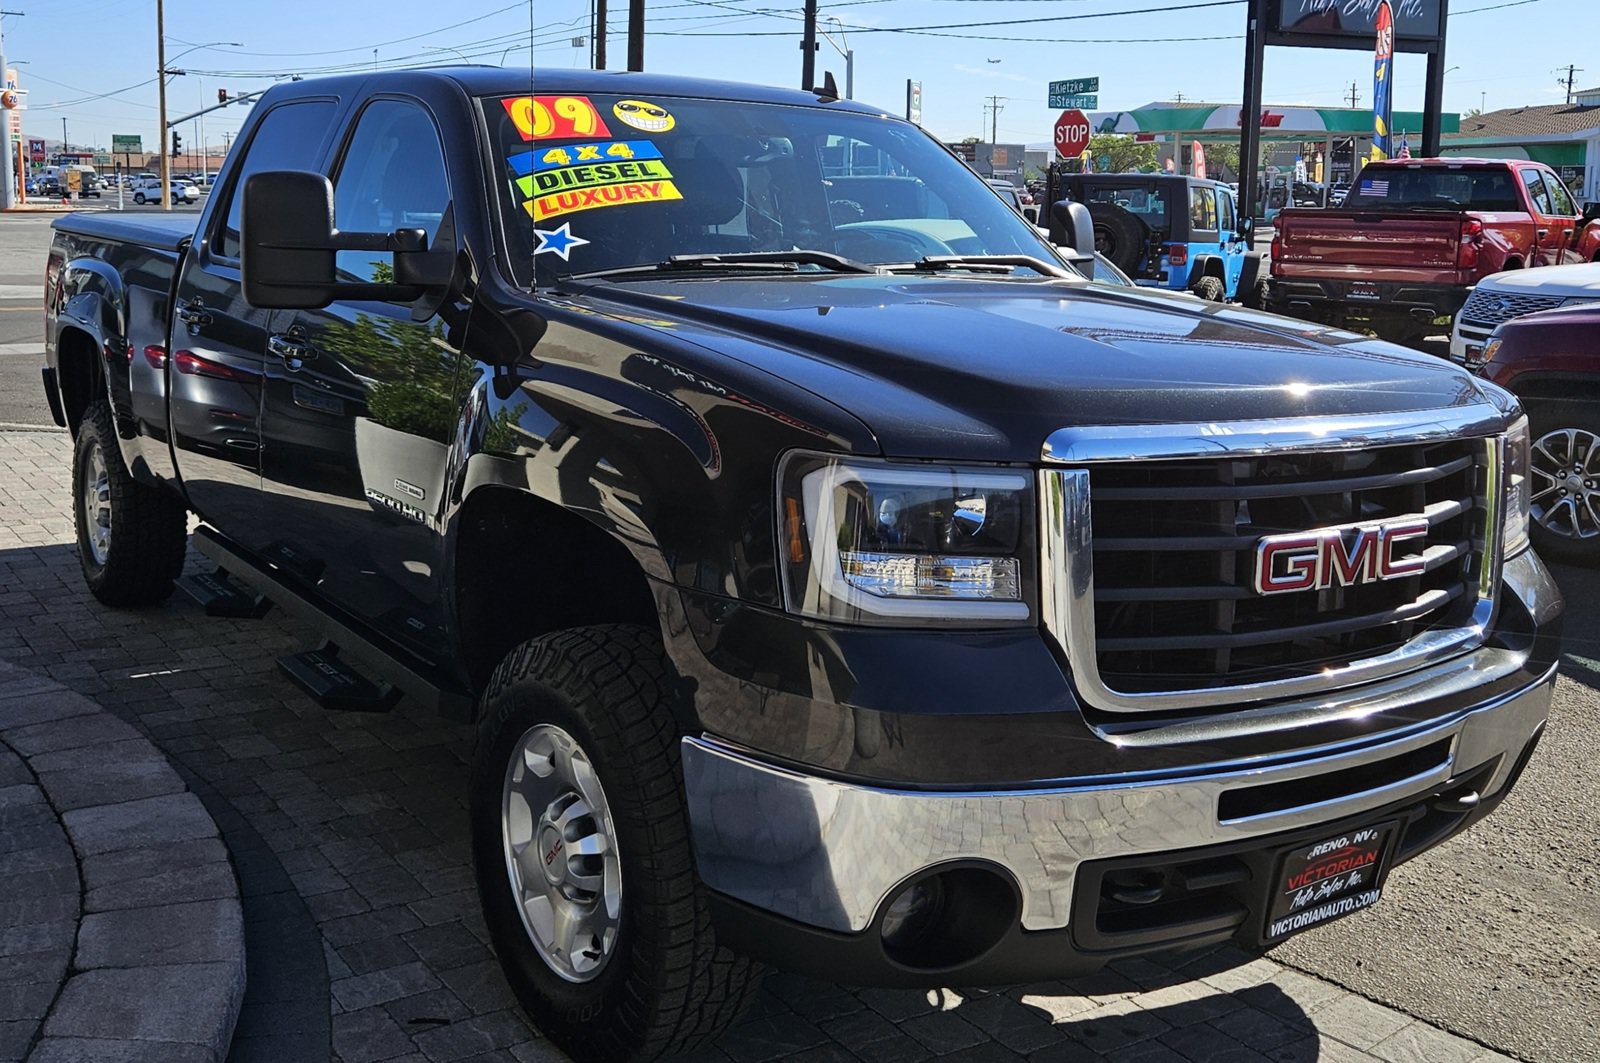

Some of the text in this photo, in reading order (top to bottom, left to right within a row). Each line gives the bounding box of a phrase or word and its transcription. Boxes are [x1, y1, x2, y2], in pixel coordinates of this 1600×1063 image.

[8, 95, 18, 104] 76
[1055, 81, 1084, 95] Kietzke
[1056, 95, 1087, 108] Stewart
[510, 97, 597, 137] 09
[1056, 124, 1088, 145] STOP
[534, 162, 660, 191] DIESEL
[538, 182, 664, 216] LUXURY
[1255, 518, 1430, 596] GMC
[545, 838, 563, 866] GMC
[1311, 829, 1373, 856] RENO, NV
[1286, 850, 1378, 890] VICTORIAN
[1289, 889, 1314, 911] Auto
[1313, 877, 1344, 901] Sales
[1270, 889, 1381, 938] VICTORIANAUTO.COM
